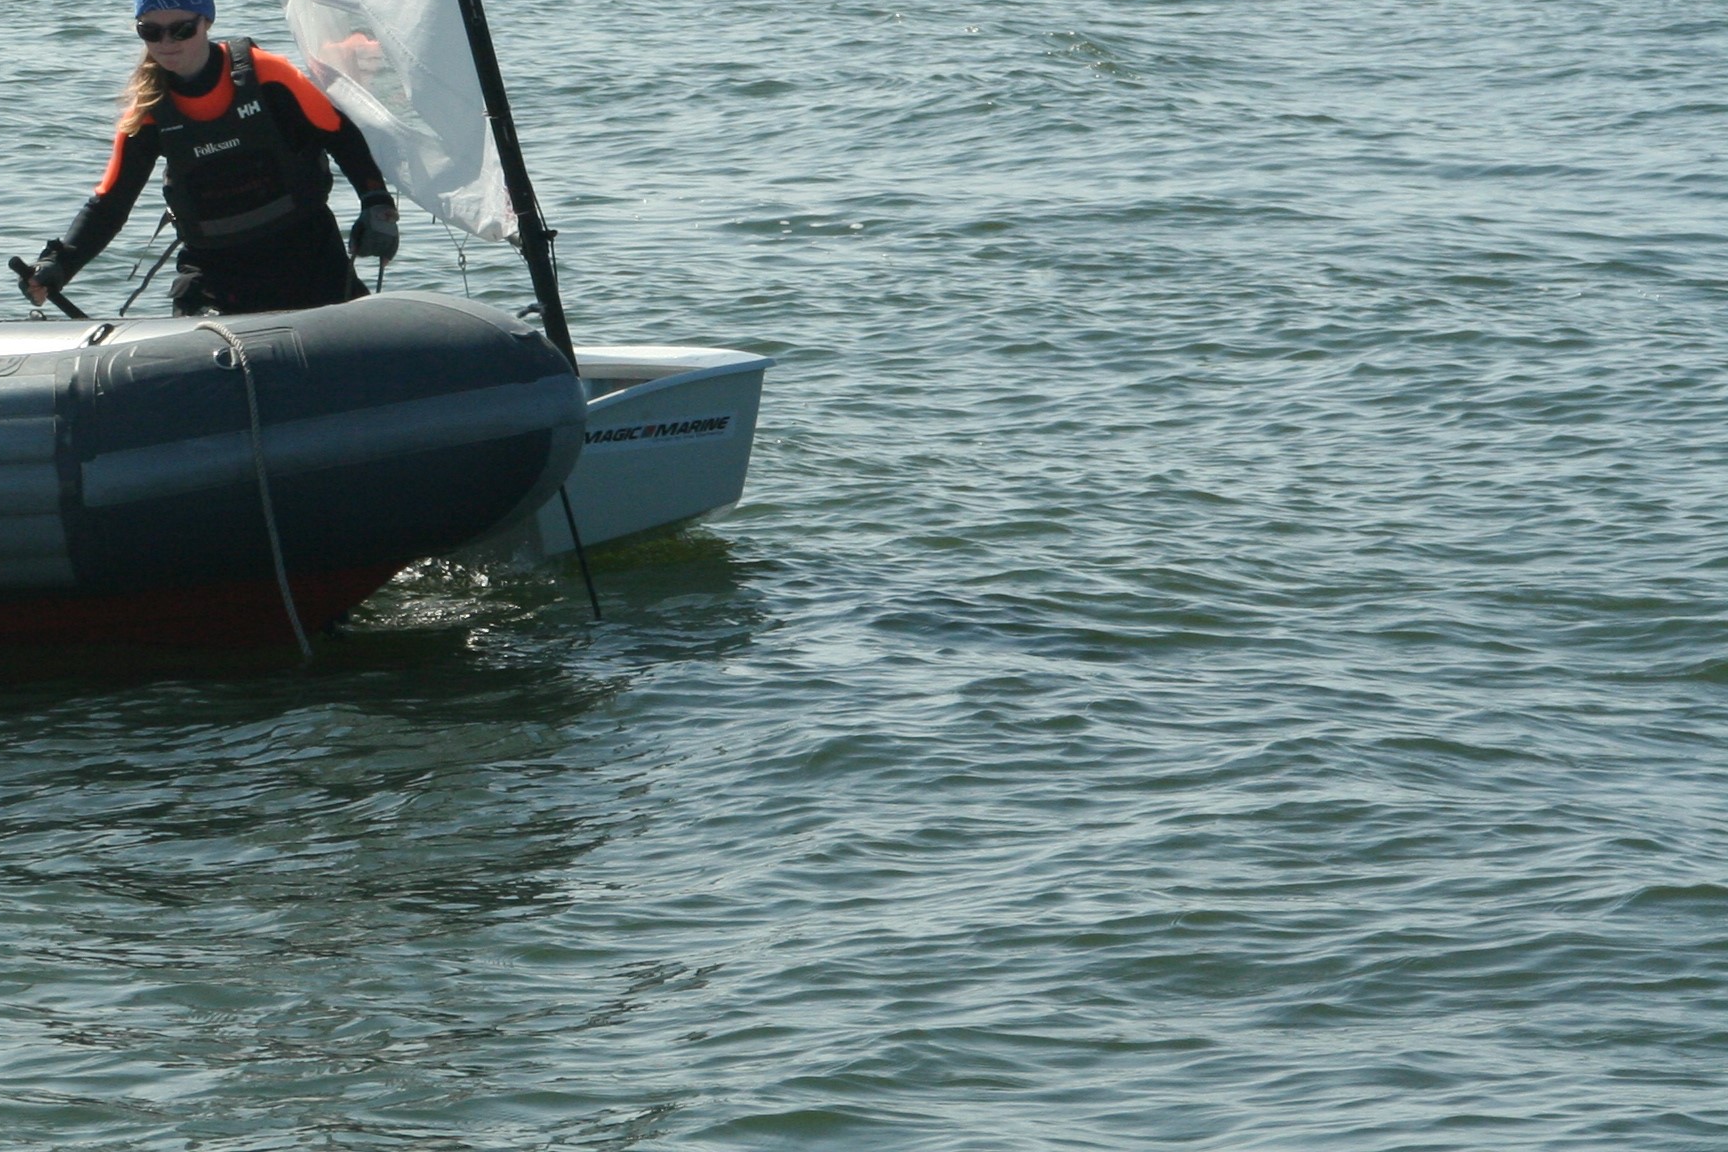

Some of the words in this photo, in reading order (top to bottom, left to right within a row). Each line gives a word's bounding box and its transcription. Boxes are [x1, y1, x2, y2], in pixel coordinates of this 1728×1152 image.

[236, 100, 262, 120] HH
[193, 137, 241, 158] Folksam
[654, 415, 732, 438] MARINE
